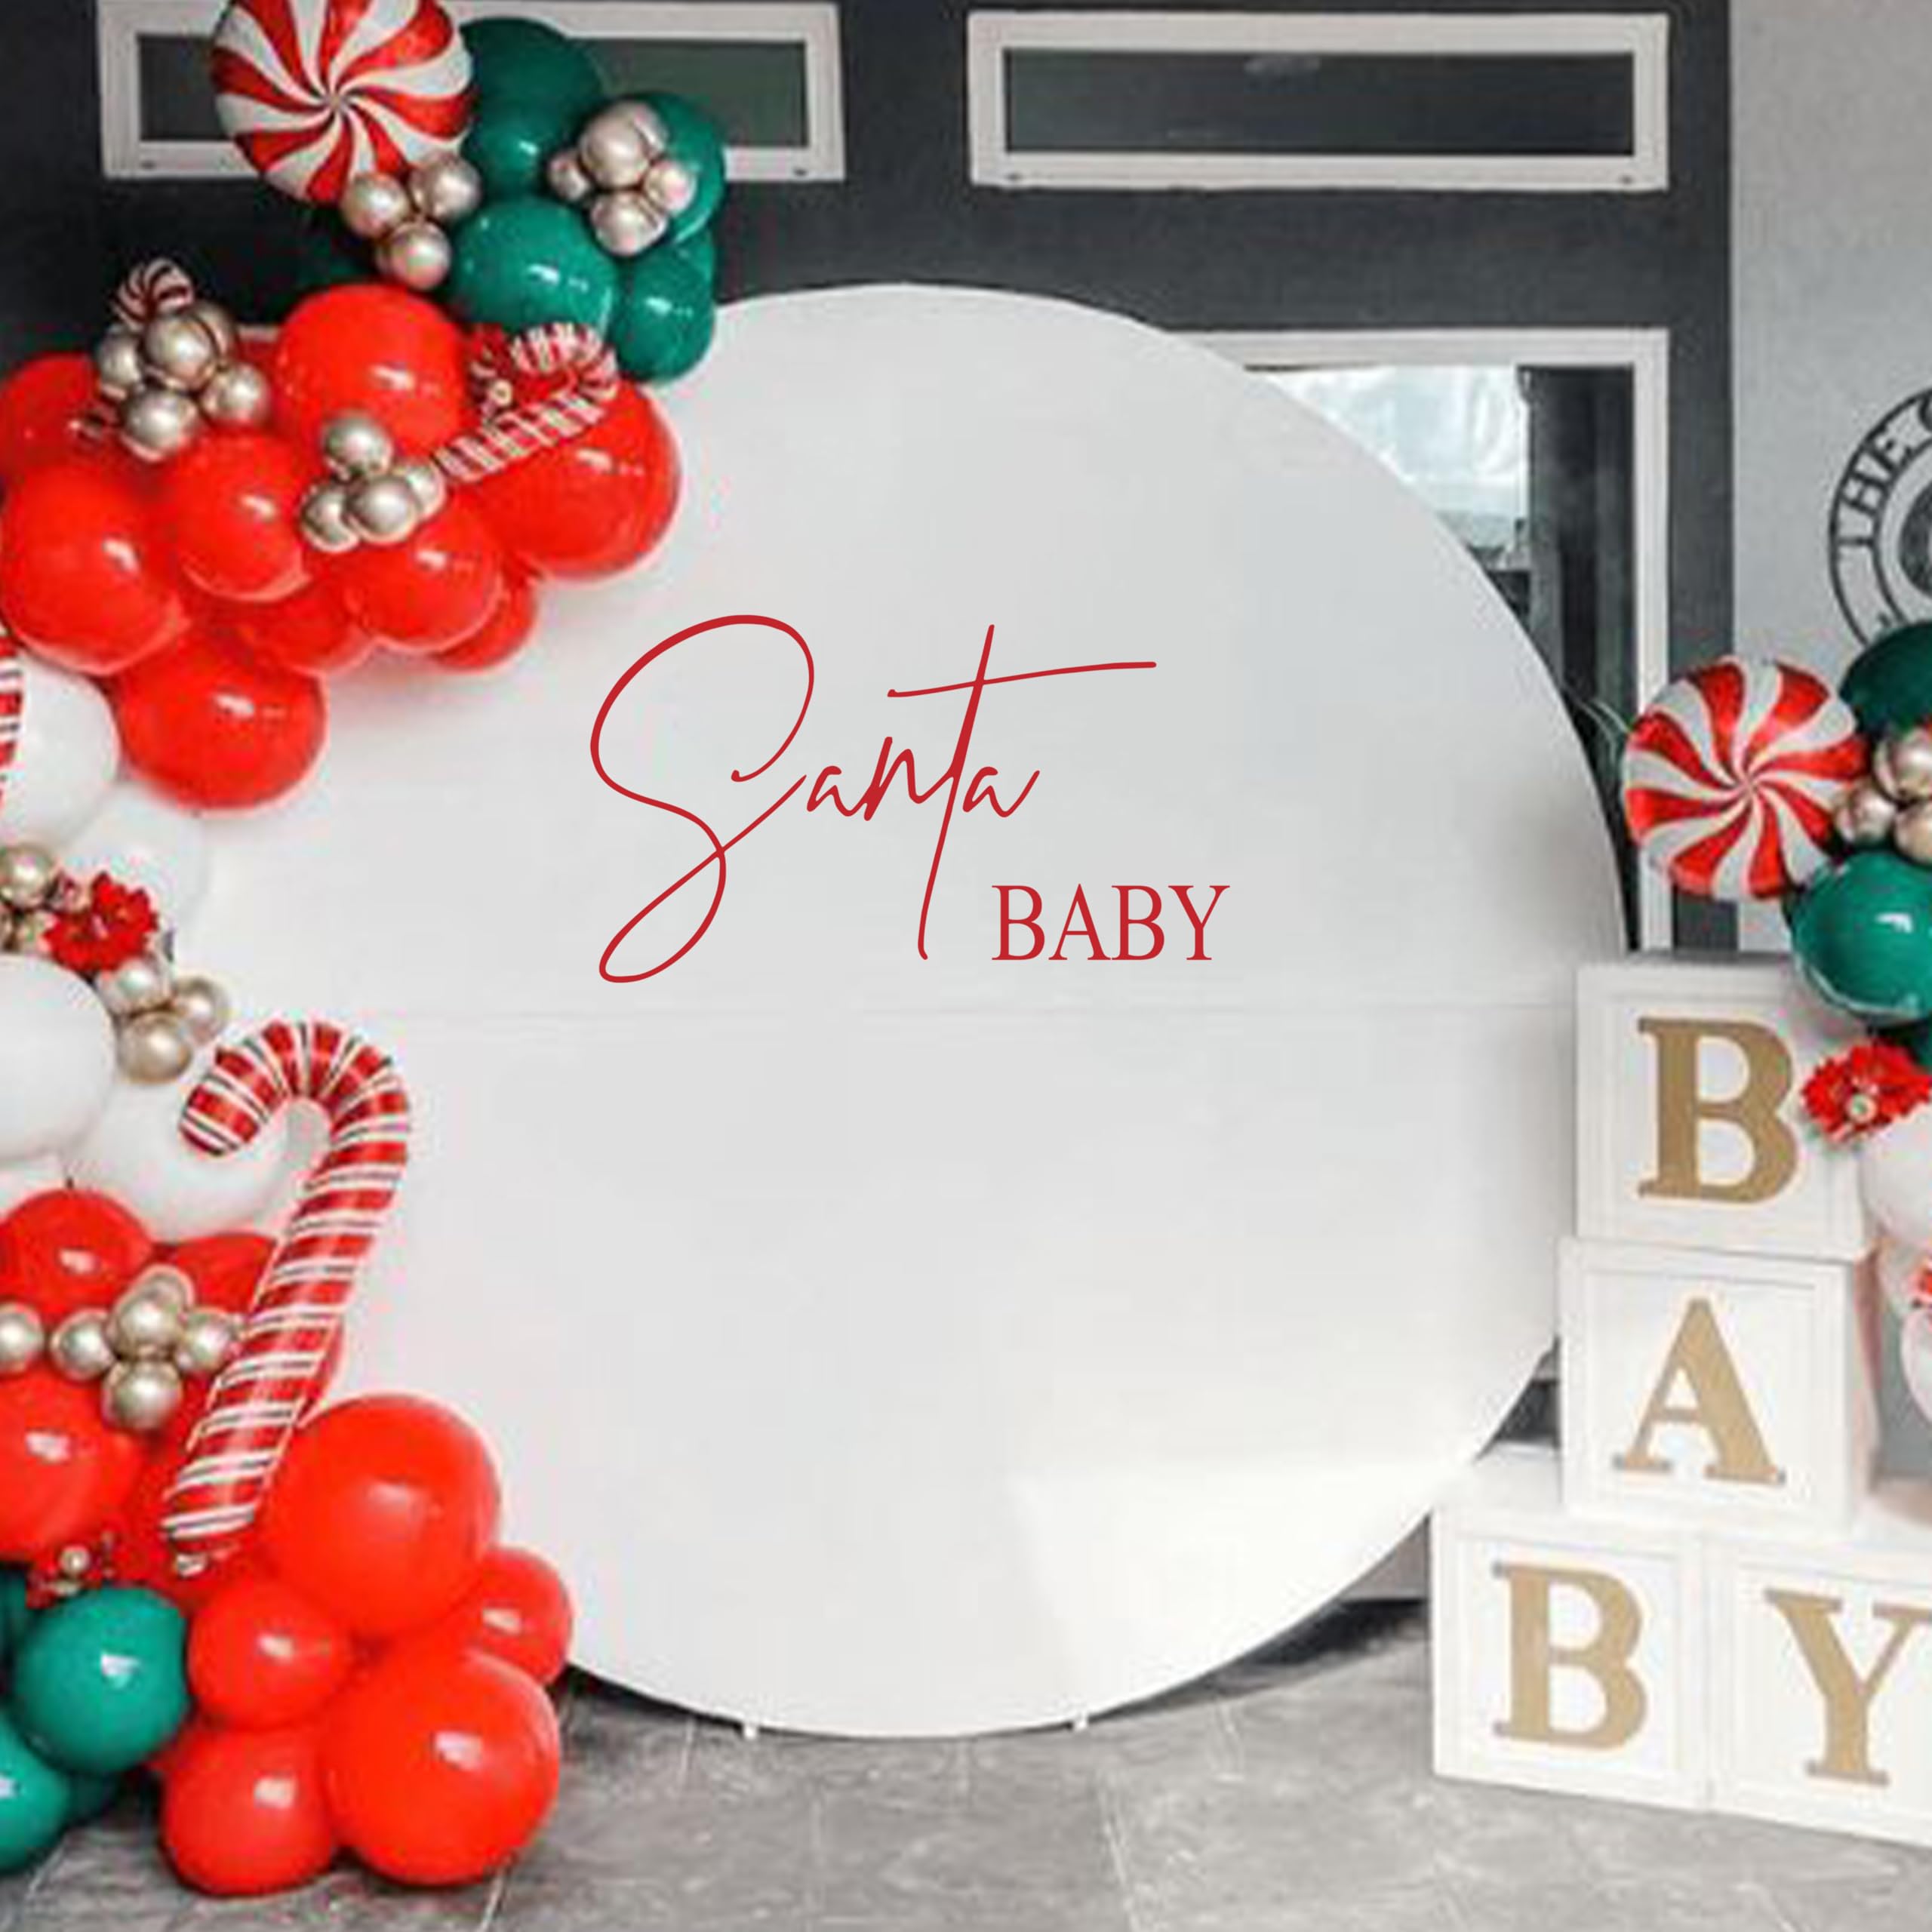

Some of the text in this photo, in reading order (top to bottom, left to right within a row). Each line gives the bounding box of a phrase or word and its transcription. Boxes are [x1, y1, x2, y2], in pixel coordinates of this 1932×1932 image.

[1835, 420, 1911, 556] THE
[590, 614, 1156, 983] Santa
[992, 884, 1230, 961] BABY
[1637, 1017, 1798, 1204] B
[1614, 1297, 1786, 1485] A
